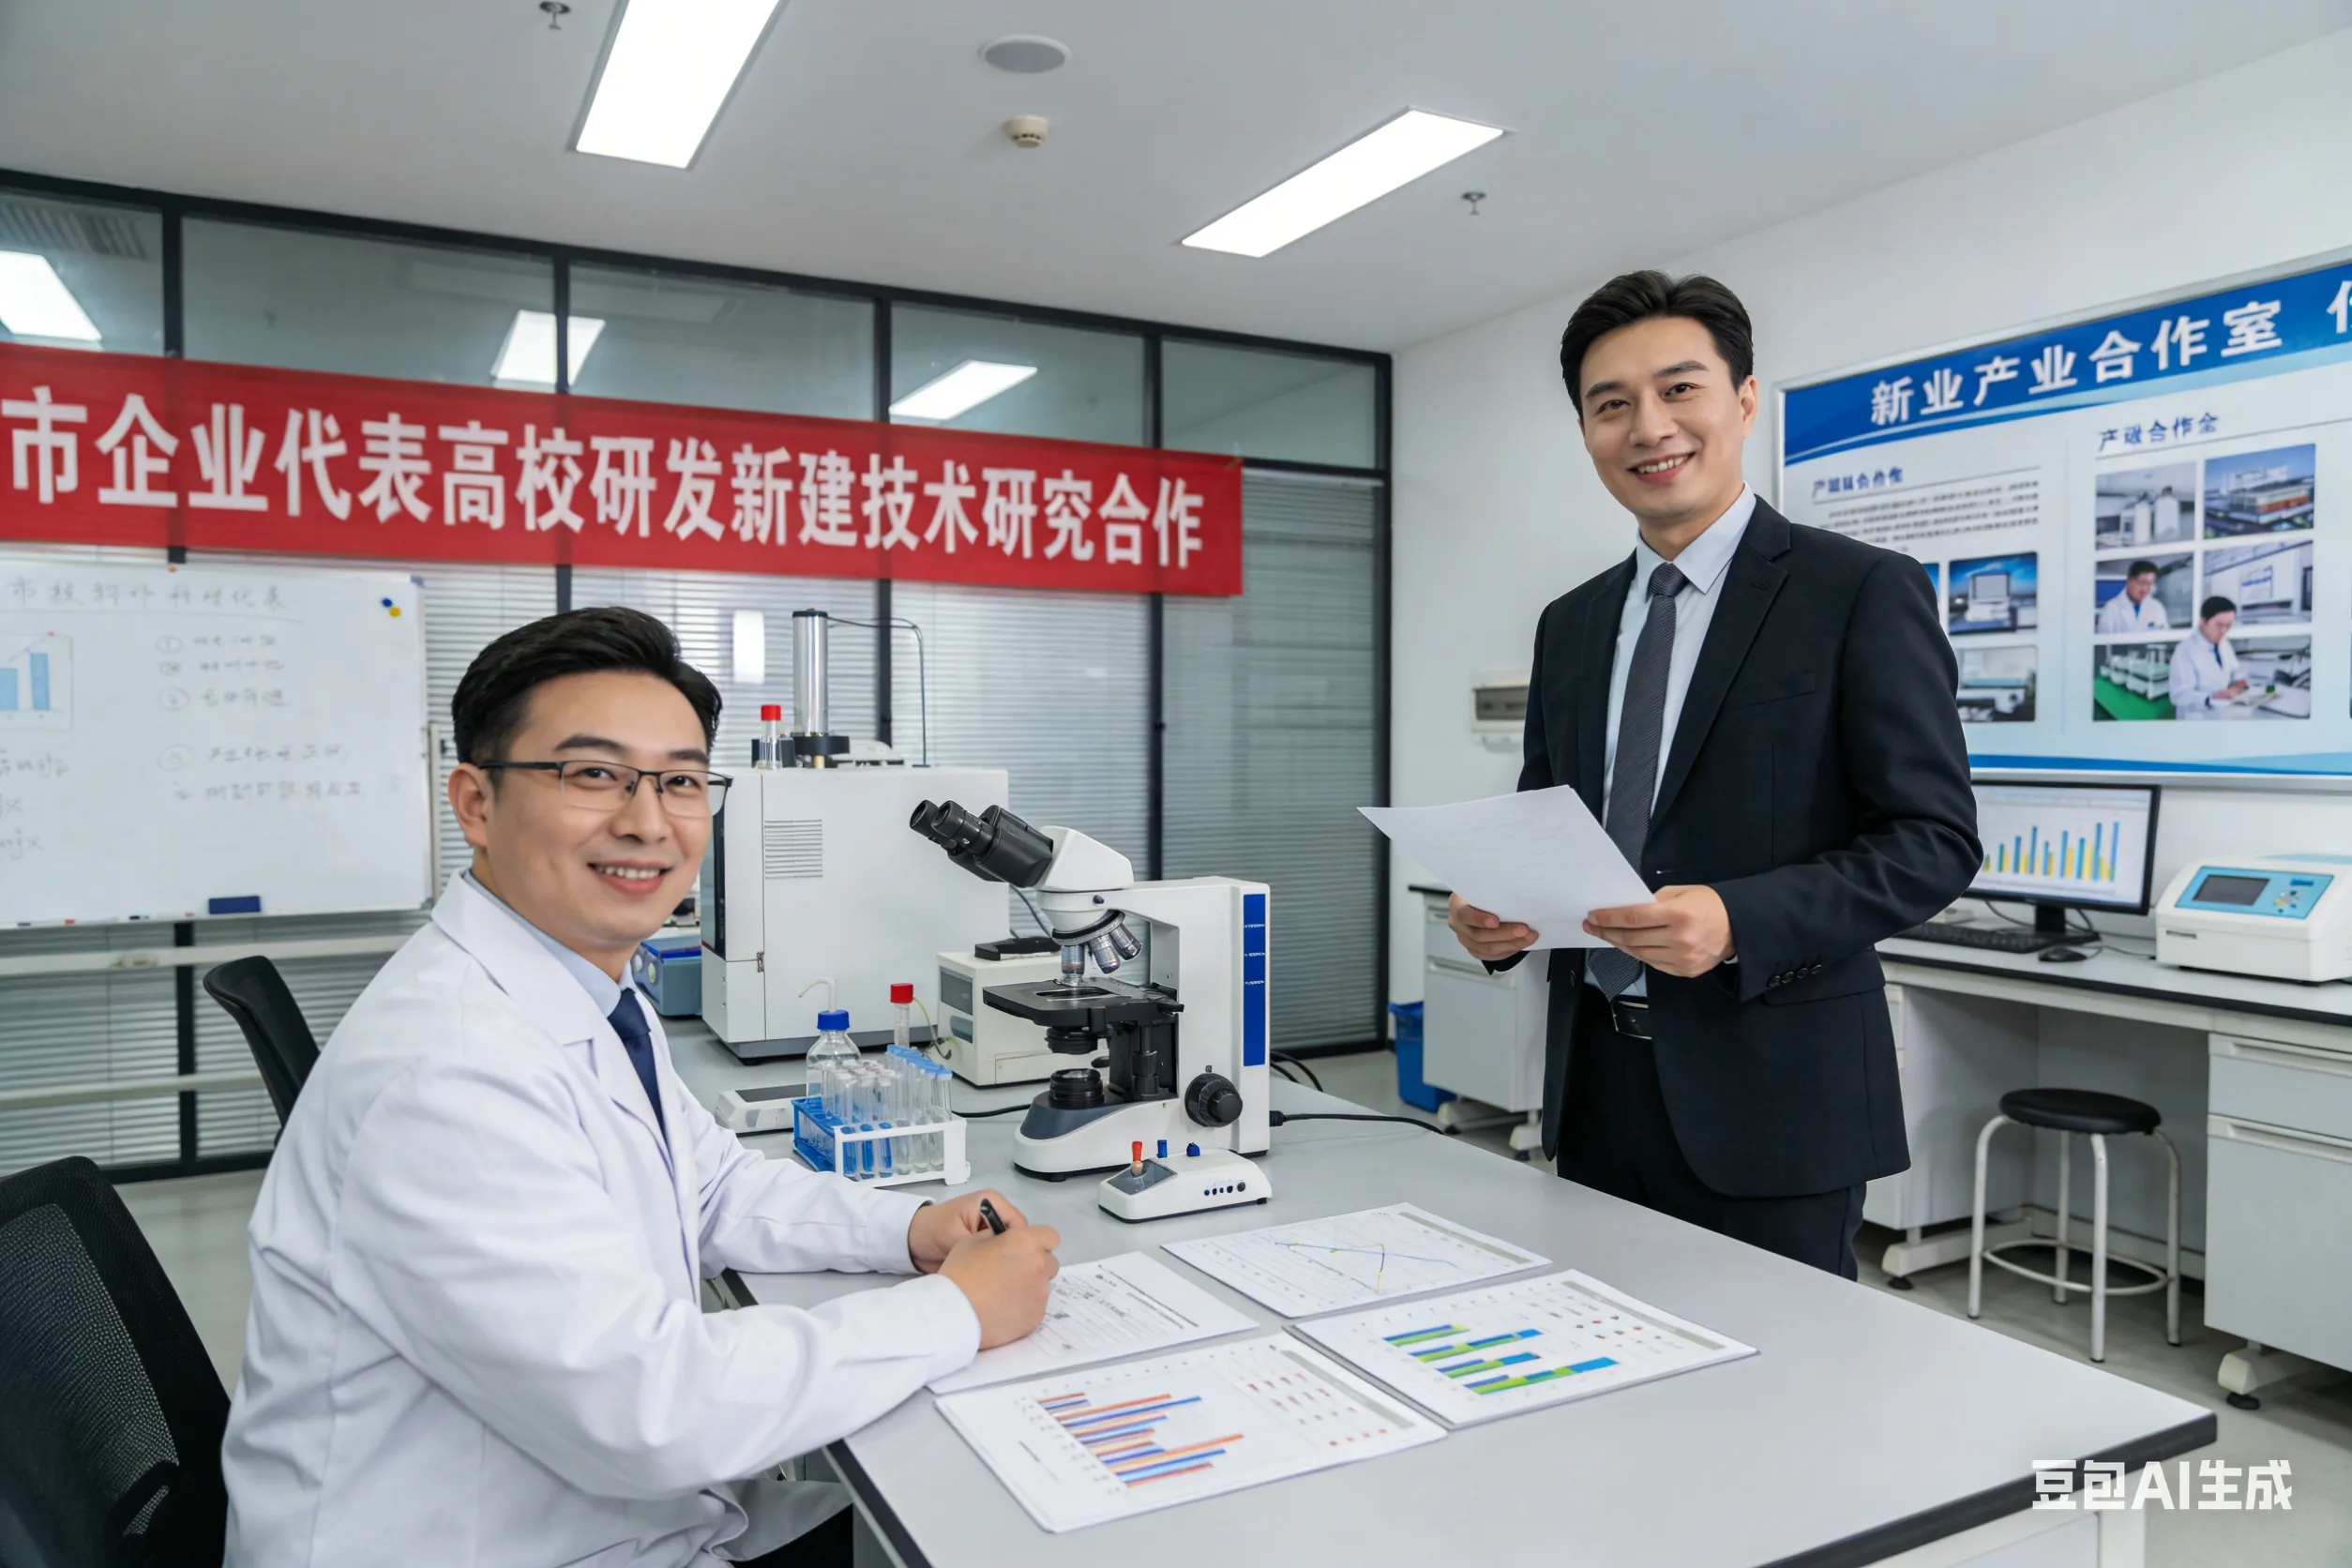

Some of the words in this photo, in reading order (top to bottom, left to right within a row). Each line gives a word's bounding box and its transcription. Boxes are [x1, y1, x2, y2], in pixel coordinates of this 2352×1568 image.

[1870, 299, 2283, 427] 新业产业合作室
[1, 385, 1204, 568] 市企业代表高校研发新建技术研究合作
